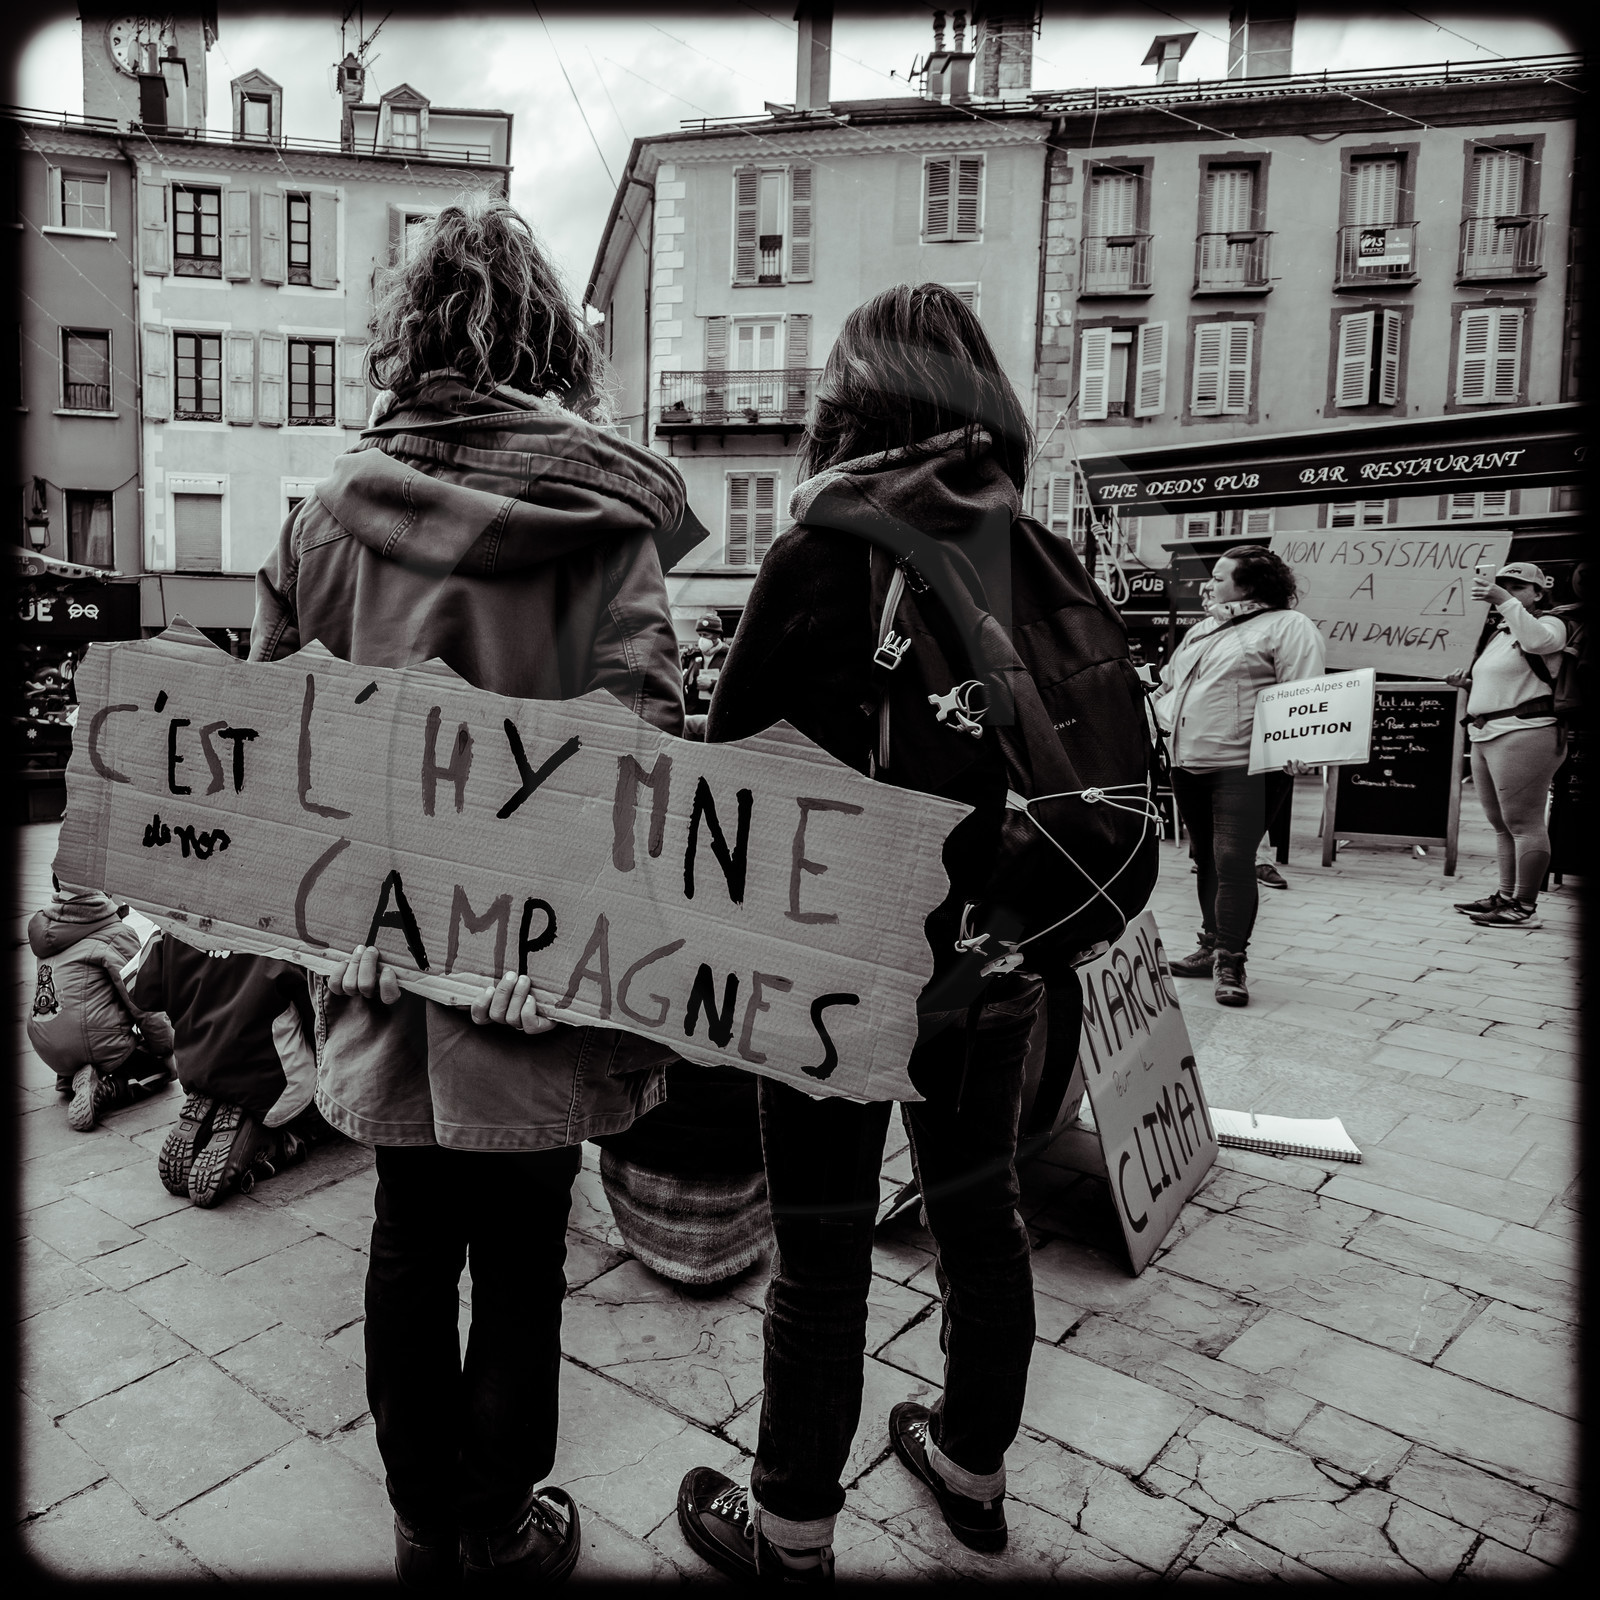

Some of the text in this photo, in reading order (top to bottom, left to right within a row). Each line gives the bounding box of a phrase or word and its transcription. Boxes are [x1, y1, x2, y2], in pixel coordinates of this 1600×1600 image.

[1099, 449, 1526, 499] THE DED'S PUB BAR RESTAURANT
[1281, 541, 1325, 564] NON
[1132, 578, 1164, 591] PUB
[1350, 573, 1374, 600] A
[1329, 621, 1358, 642] EN
[1262, 680, 1361, 703] Les Hautes-Alpes en
[1288, 702, 1329, 718] POLE
[1053, 718, 1077, 730] CHUA
[1264, 721, 1352, 743] POLLUTION
[88, 690, 259, 796] C'EST
[142, 812, 232, 860] de nos
[295, 836, 861, 1080] CAMPAGNES
[1082, 926, 1181, 1075] MARCHE
[1118, 1055, 1214, 1234] CLIMAT
